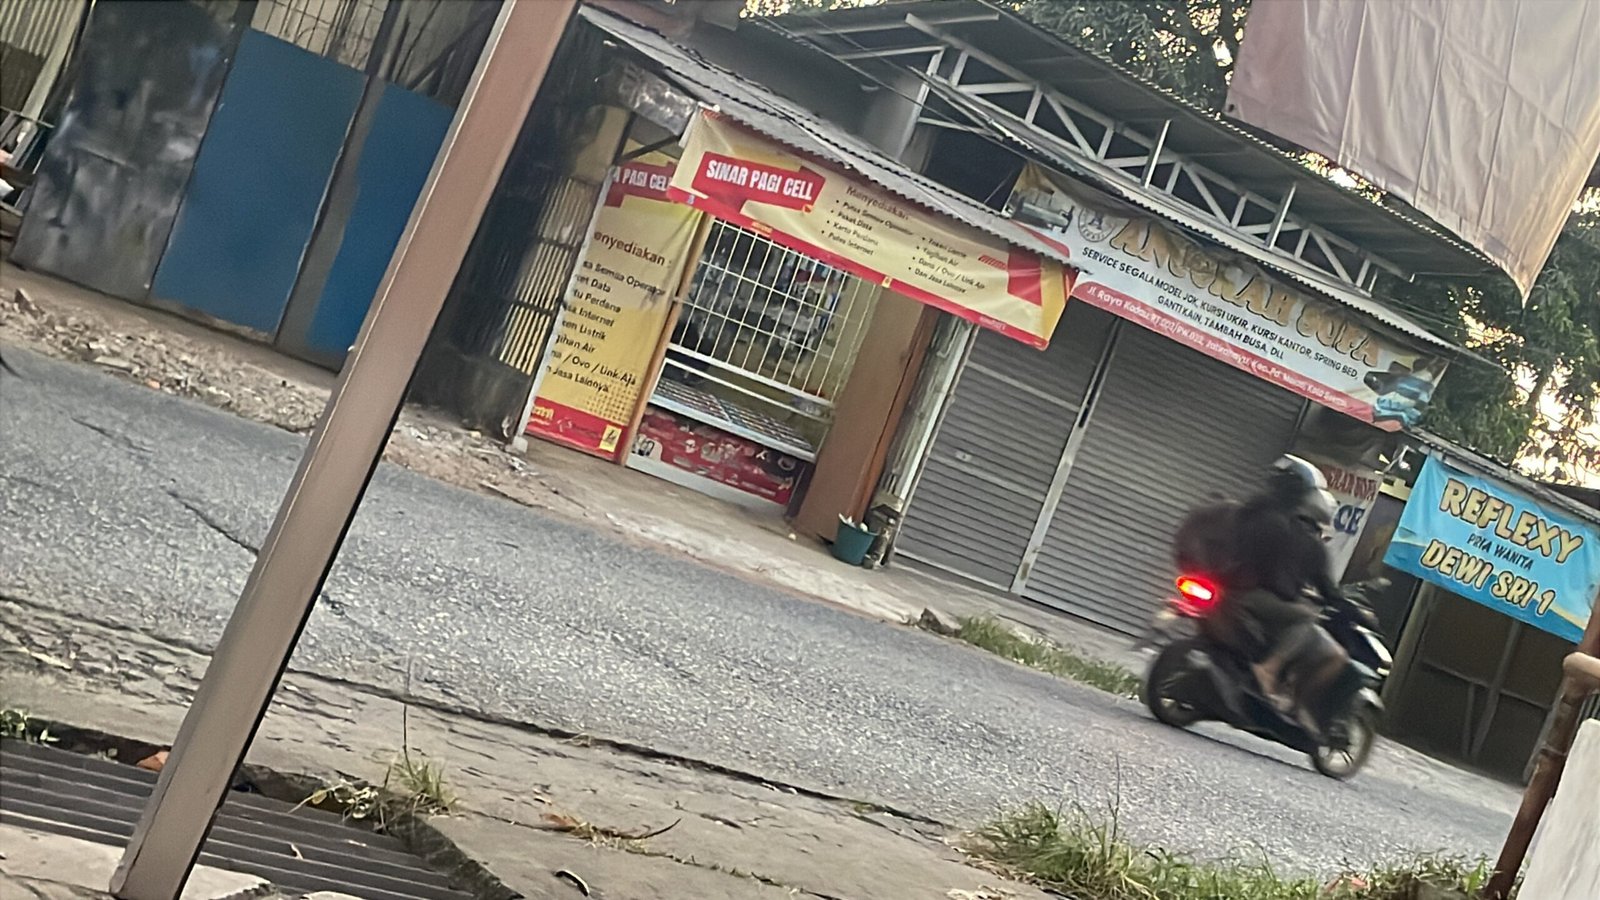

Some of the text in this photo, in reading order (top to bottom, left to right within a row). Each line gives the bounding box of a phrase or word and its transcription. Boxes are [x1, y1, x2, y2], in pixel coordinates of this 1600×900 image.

[622, 168, 648, 187] PAGI
[706, 160, 813, 200] SINAR PAGI CELL
[594, 231, 666, 266] enyediakan
[591, 279, 611, 293] Data
[595, 261, 625, 281] Semua
[626, 275, 666, 296] Operator
[585, 292, 621, 313] Perdana
[1082, 247, 1120, 268] SERVICE
[1119, 263, 1154, 285] SEGALA
[1155, 279, 1183, 299] MODEL
[1200, 302, 1225, 319] KURSI
[1251, 325, 1278, 342] KURSI
[1278, 337, 1312, 359] KANTOR,
[1315, 352, 1341, 370] SPRING
[1097, 290, 1122, 306] Raya
[578, 308, 615, 327] Internet
[1205, 317, 1242, 341] TAMBAH
[580, 324, 607, 340] Listrik
[582, 342, 595, 353] Air
[572, 356, 590, 369] Ovo
[553, 368, 573, 379] Jasa
[575, 374, 609, 392] Lainnya
[1439, 478, 1584, 564] REFLEXY
[1467, 533, 1534, 571] PRIA WANITA
[1420, 539, 1556, 616] DEWI SRI 1
